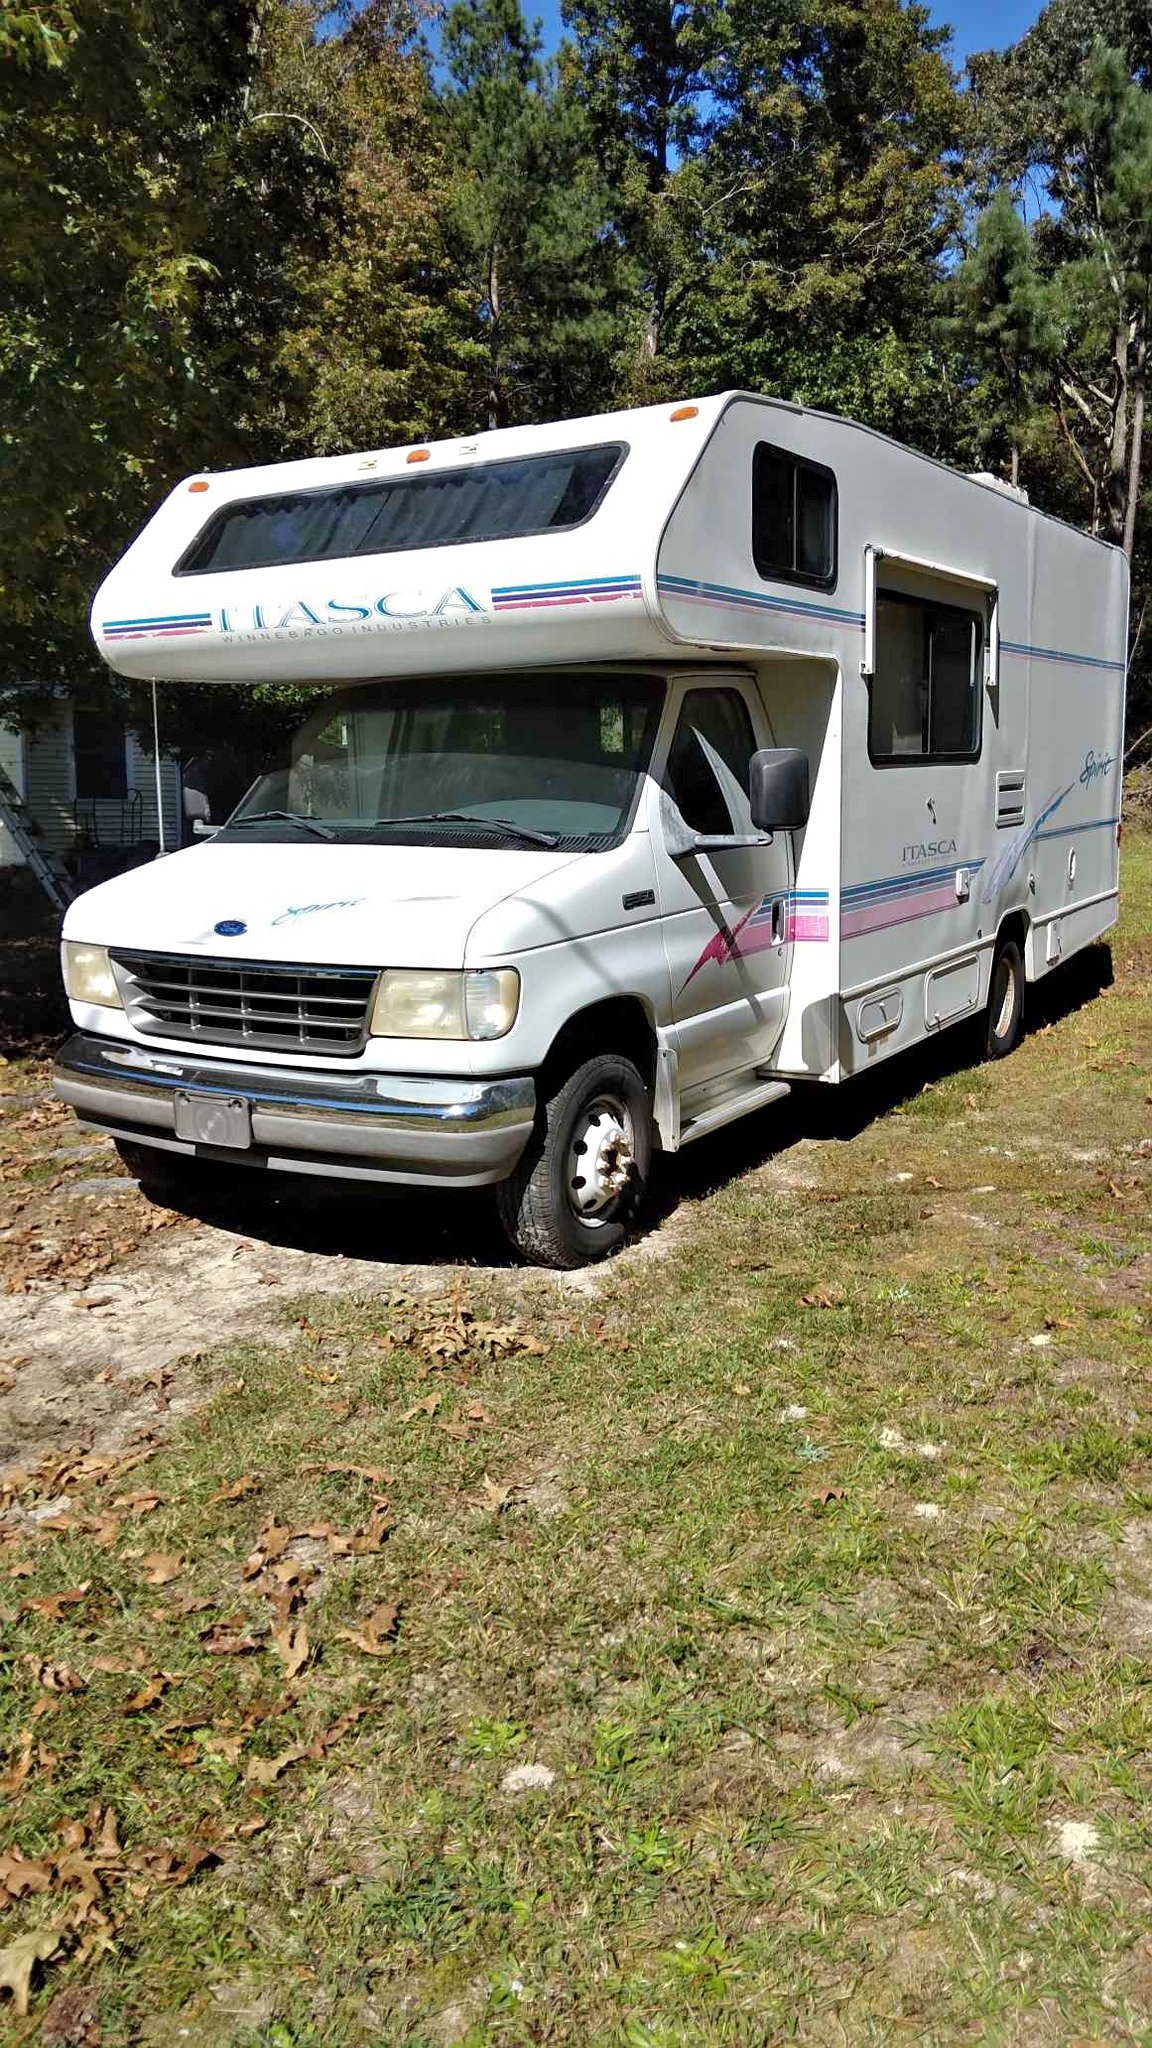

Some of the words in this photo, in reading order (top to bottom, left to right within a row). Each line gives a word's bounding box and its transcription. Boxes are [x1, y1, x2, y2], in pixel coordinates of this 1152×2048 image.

[219, 586, 488, 633] ITASCA
[222, 627, 343, 643] WINNEBAGO
[351, 616, 492, 634] INDUSTRIES
[1079, 750, 1119, 790] Spirit
[902, 839, 957, 861] ITASCA
